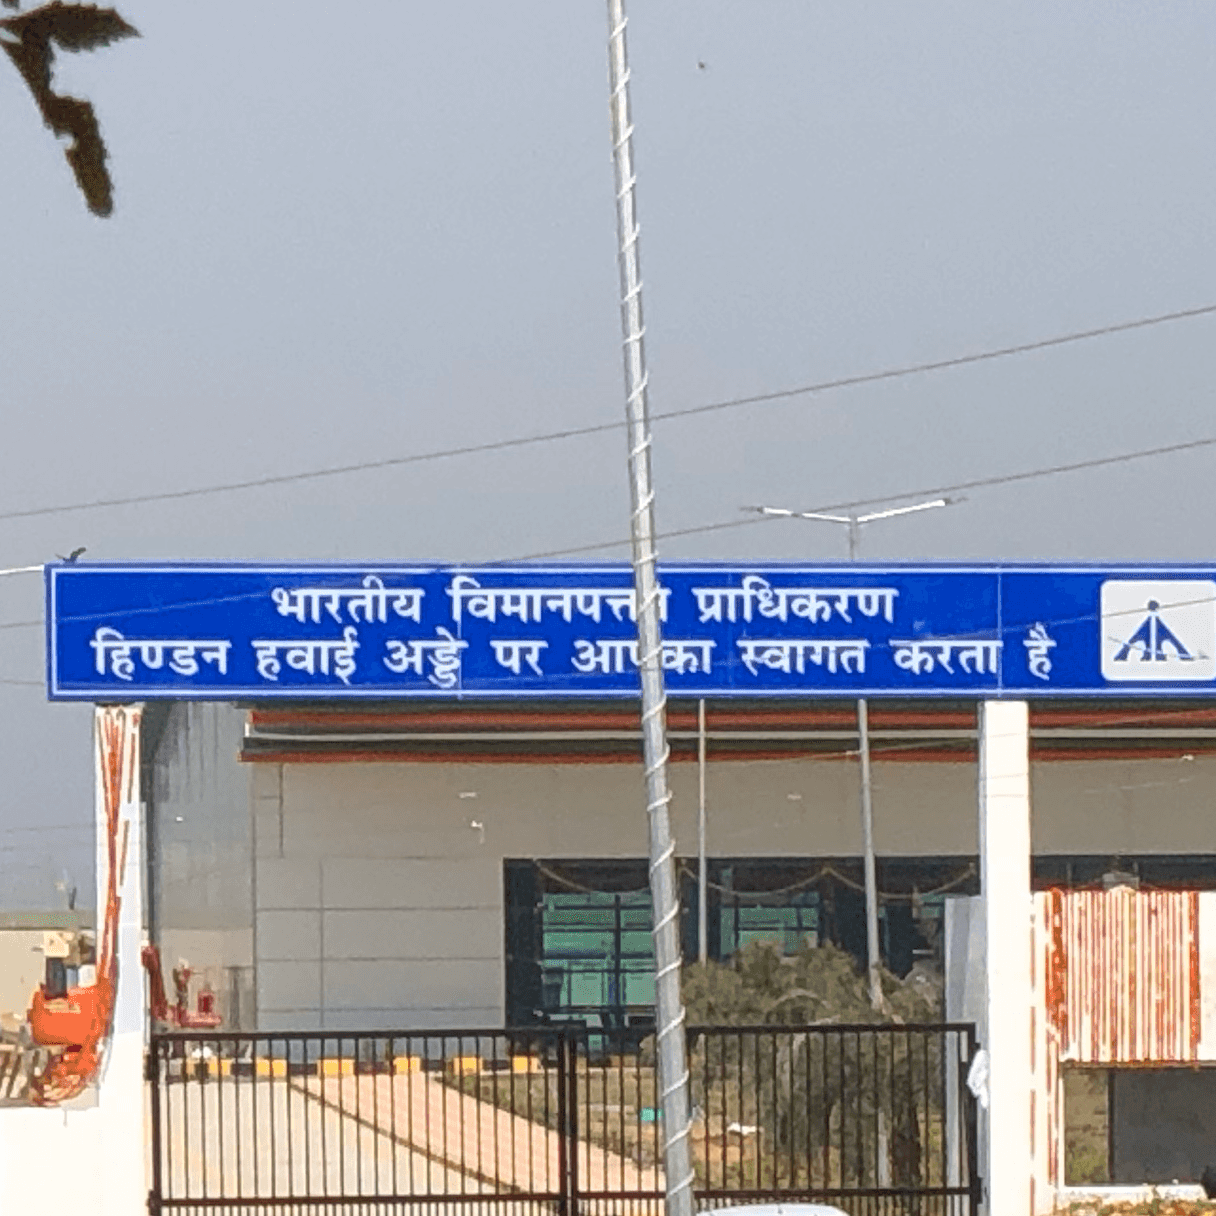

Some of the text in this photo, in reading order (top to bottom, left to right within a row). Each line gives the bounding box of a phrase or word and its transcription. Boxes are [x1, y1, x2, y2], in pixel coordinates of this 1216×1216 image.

[272, 576, 424, 621] भारतीय
[693, 576, 897, 621] प्राधिकरण
[91, 628, 230, 680] हिण्डन
[253, 627, 358, 683] हवाई
[385, 628, 467, 687] अड्डे
[491, 641, 547, 673] पर
[737, 641, 869, 674] स्वागत
[890, 640, 1002, 673] करता
[1024, 625, 1055, 678] है
